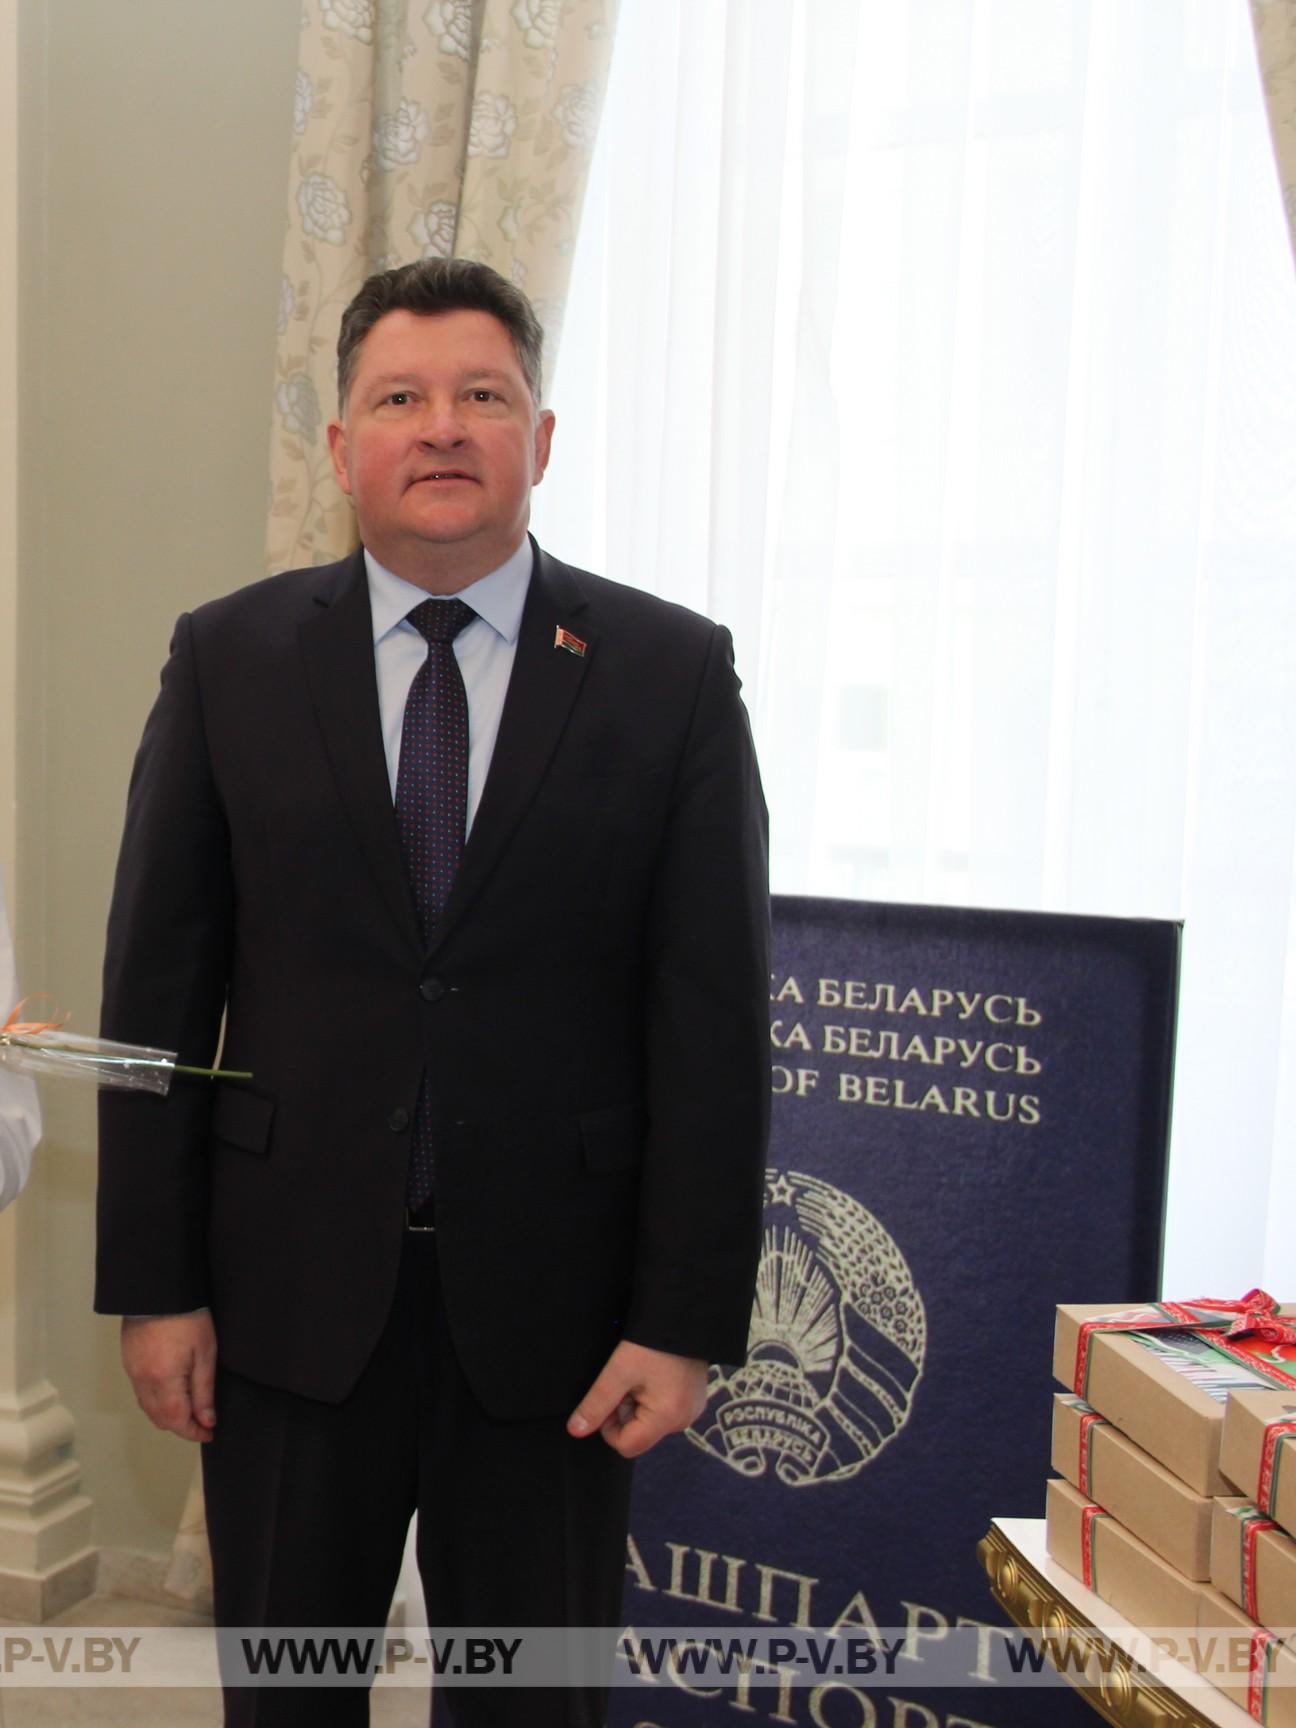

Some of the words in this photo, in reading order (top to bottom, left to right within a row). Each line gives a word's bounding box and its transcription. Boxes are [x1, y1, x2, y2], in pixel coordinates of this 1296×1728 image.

[816, 977, 1043, 1027] БЕЛАРУСЬ
[822, 1024, 1043, 1076] БЕЛАРУСЬ
[837, 1072, 1042, 1125] BELARUS
[625, 1532, 1015, 1683] АШПАРТ
